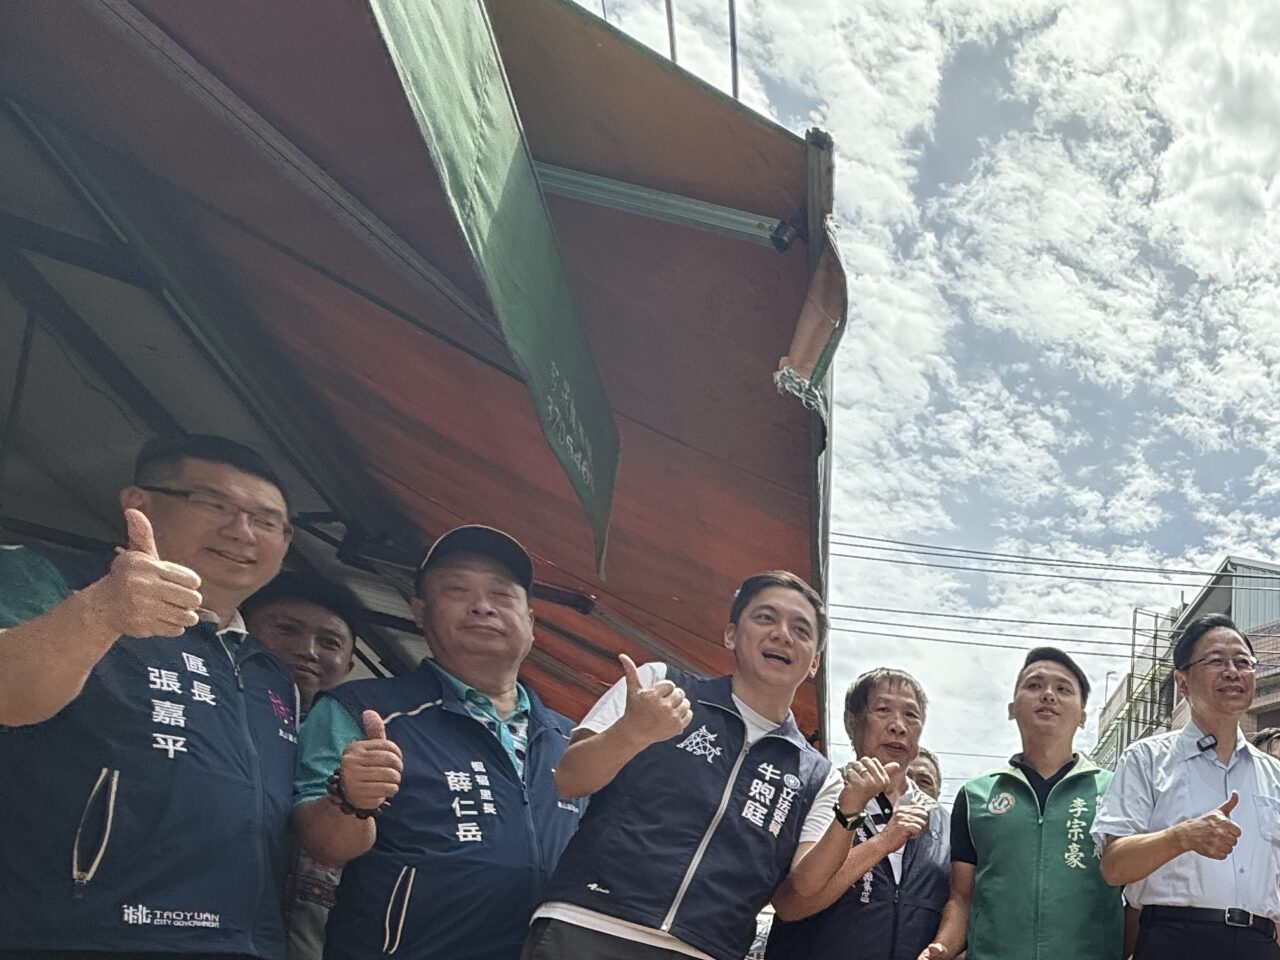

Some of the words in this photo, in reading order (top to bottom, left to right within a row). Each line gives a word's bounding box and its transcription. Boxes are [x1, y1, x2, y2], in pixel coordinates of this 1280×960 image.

[181, 652, 216, 706] 區長
[147, 667, 188, 759] 張嘉平
[444, 771, 483, 842] 薛仁岳
[741, 762, 781, 827] 牛煦庭
[768, 786, 798, 838] 立法委員
[1064, 797, 1088, 868] 李宗豪
[153, 910, 220, 922] TAOYUAN
